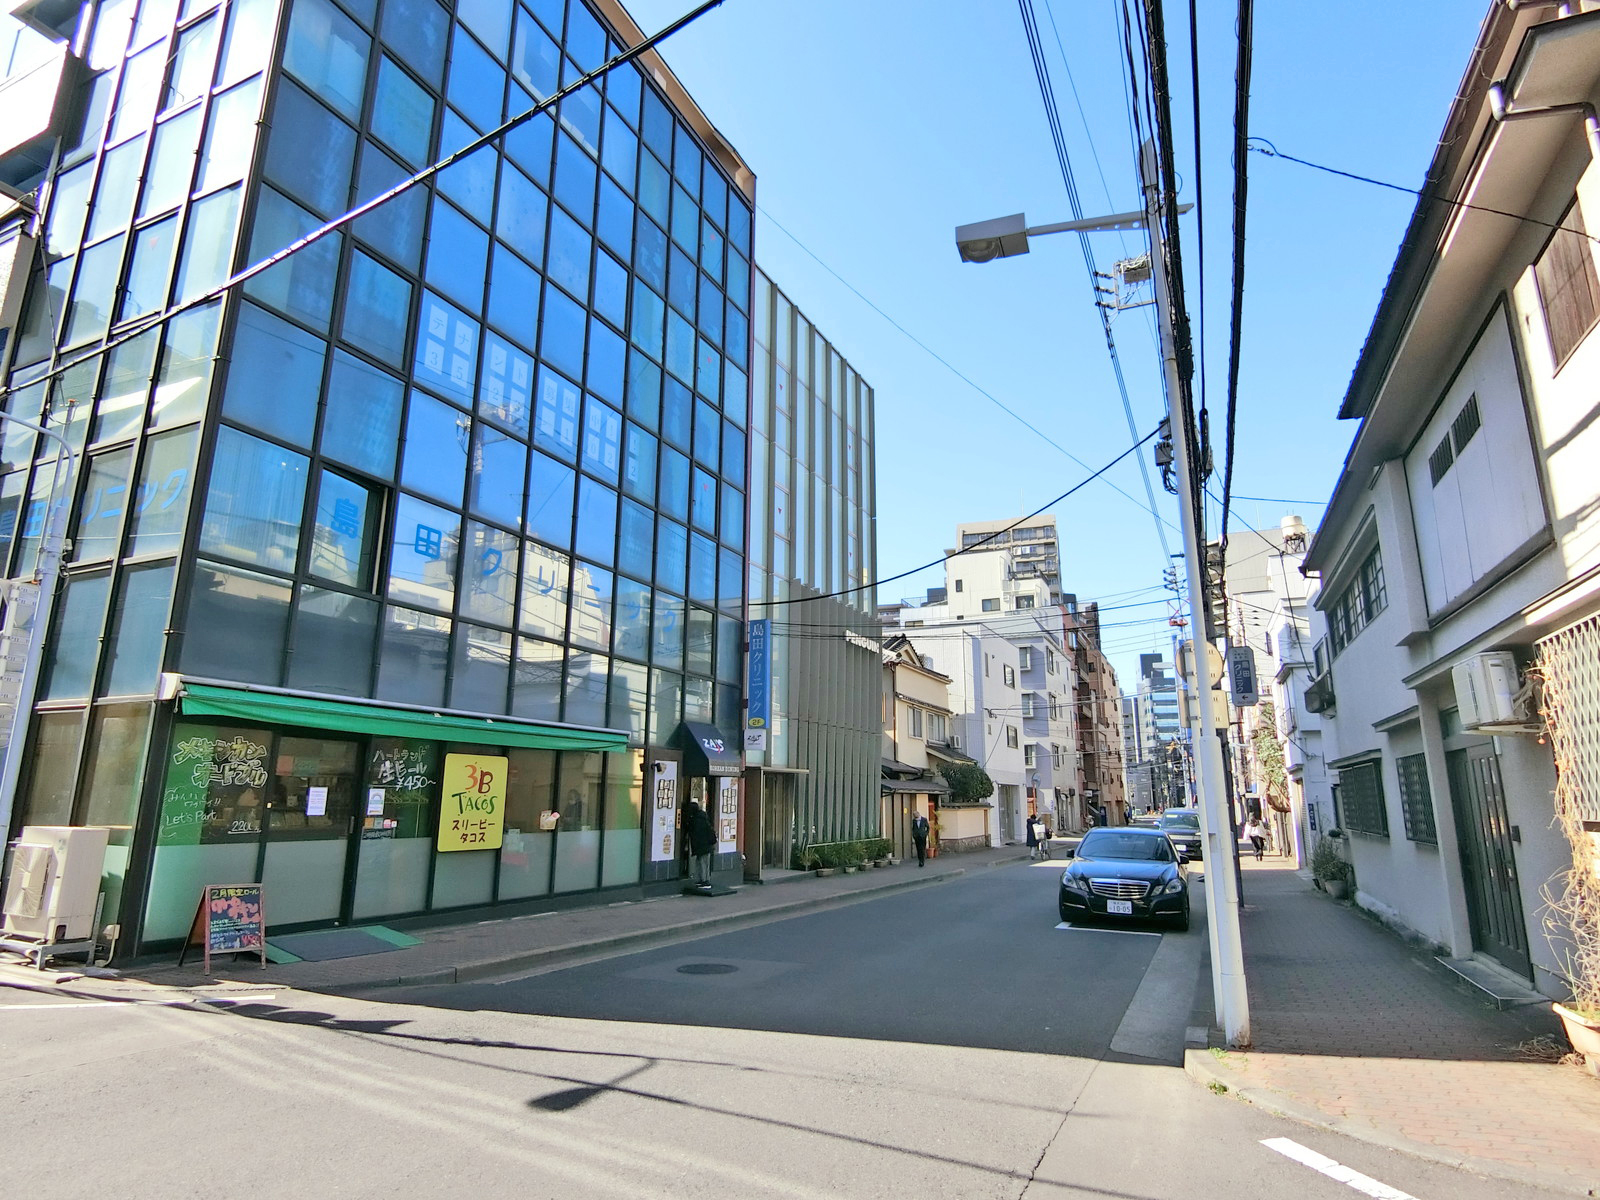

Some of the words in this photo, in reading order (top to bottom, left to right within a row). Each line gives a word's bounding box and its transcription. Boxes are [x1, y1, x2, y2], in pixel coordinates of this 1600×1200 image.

[331, 497, 677, 633] 島田クリニック
[845, 629, 880, 654] PENGUIN
[751, 623, 764, 713] 島田クリニック
[1234, 664, 1244, 692] クリニック
[752, 718, 762, 726] 2F
[173, 736, 267, 764] メキシカン
[372, 745, 430, 763] ハートランド
[191, 760, 268, 788] オードブル
[378, 760, 428, 783] 生ビール
[465, 763, 493, 794] 3B
[451, 791, 498, 815] TACOS
[166, 812, 193, 826] Let's
[452, 819, 496, 831] スリービー
[460, 832, 486, 844] タコス
